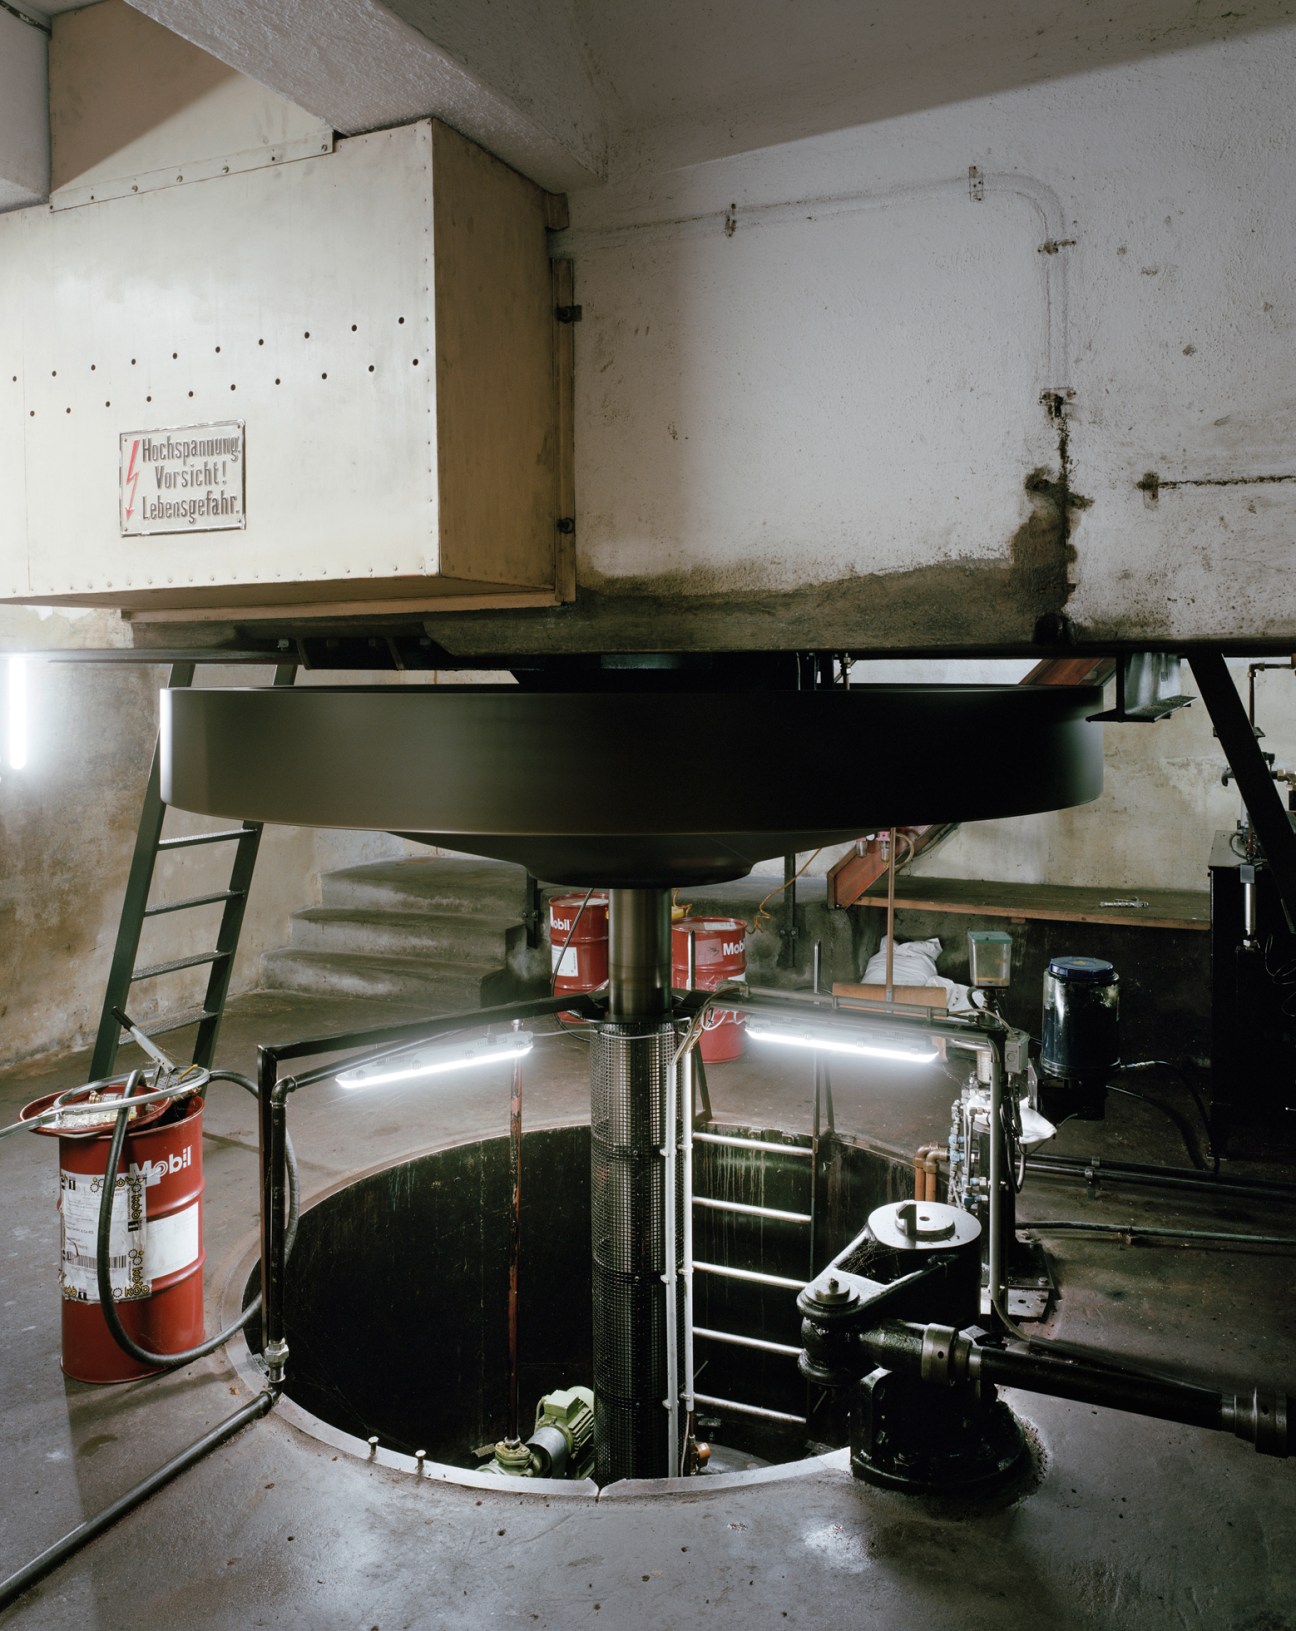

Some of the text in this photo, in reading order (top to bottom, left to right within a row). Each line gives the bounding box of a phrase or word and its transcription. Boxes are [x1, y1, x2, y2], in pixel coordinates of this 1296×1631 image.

[155, 460, 228, 490] Vorsicht!
[142, 490, 240, 525] Lebensgefahr.
[129, 1145, 192, 1188] Mobil
